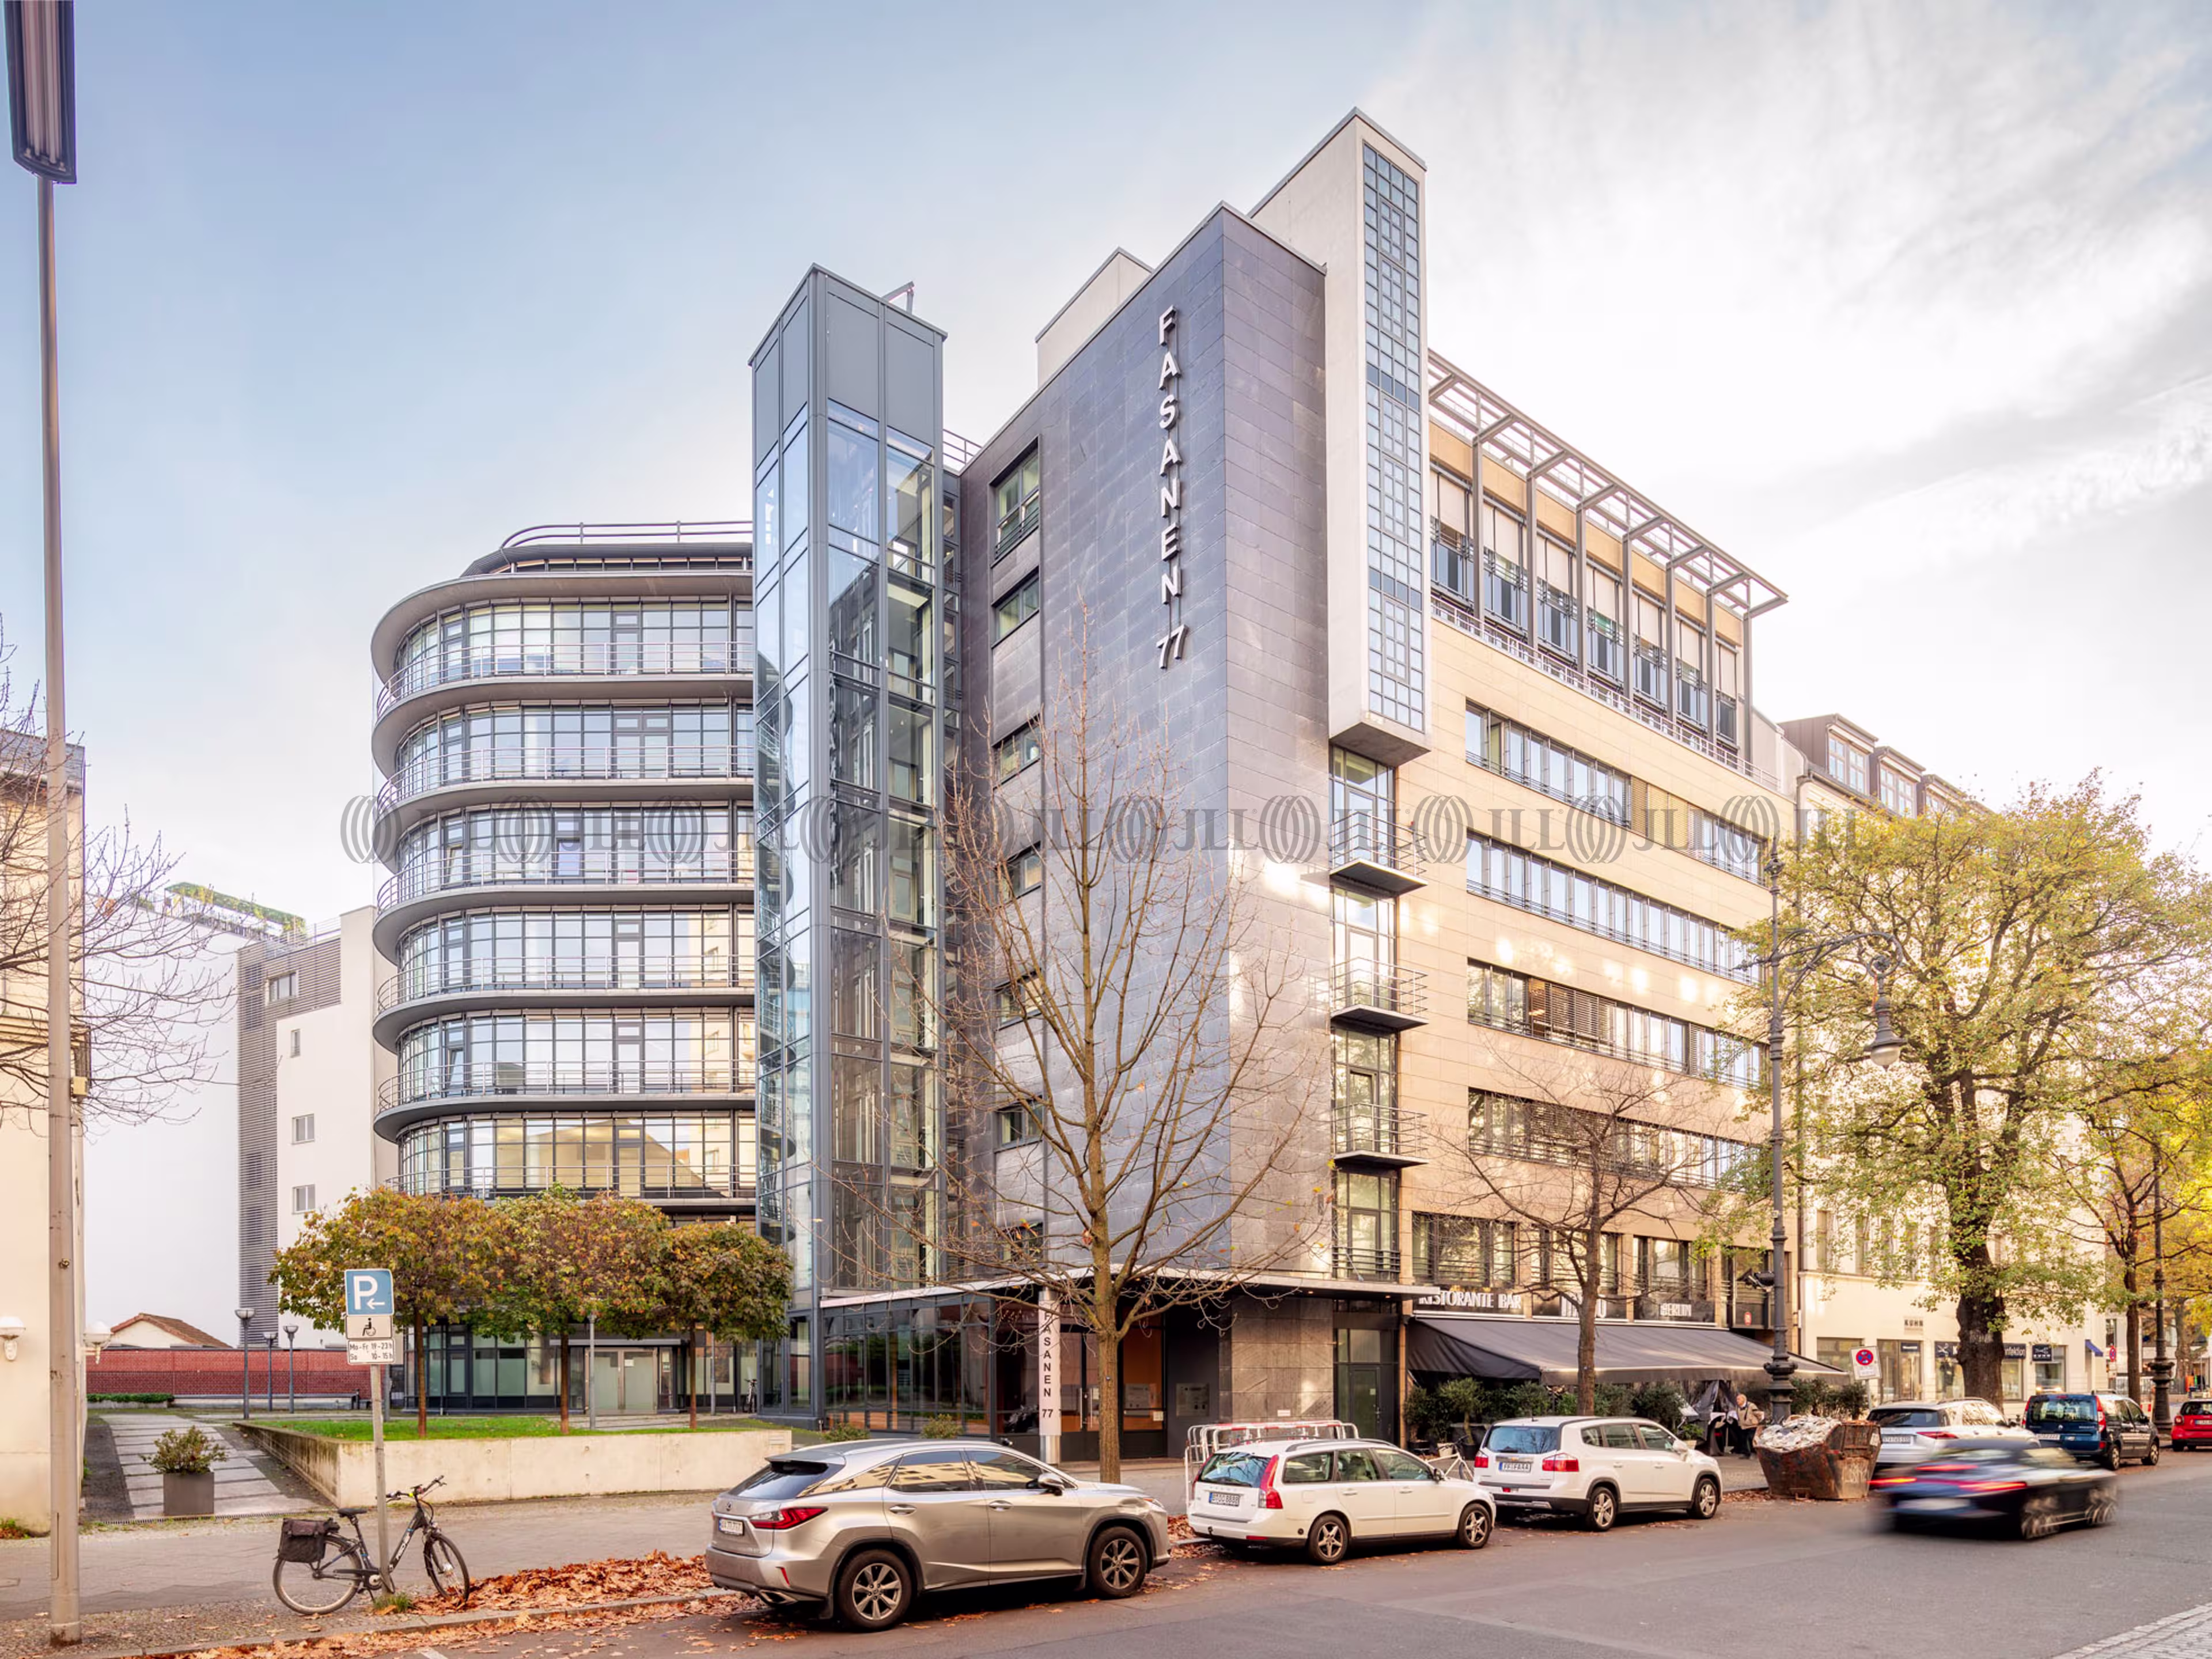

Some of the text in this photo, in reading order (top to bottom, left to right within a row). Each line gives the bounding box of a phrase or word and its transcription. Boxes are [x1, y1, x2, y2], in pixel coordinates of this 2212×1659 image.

[1156, 305, 1188, 669] FASANEN 77
[354, 1275, 378, 1310] P
[1498, 1294, 1521, 1309] BAR
[1041, 1409, 1054, 1418] 77
